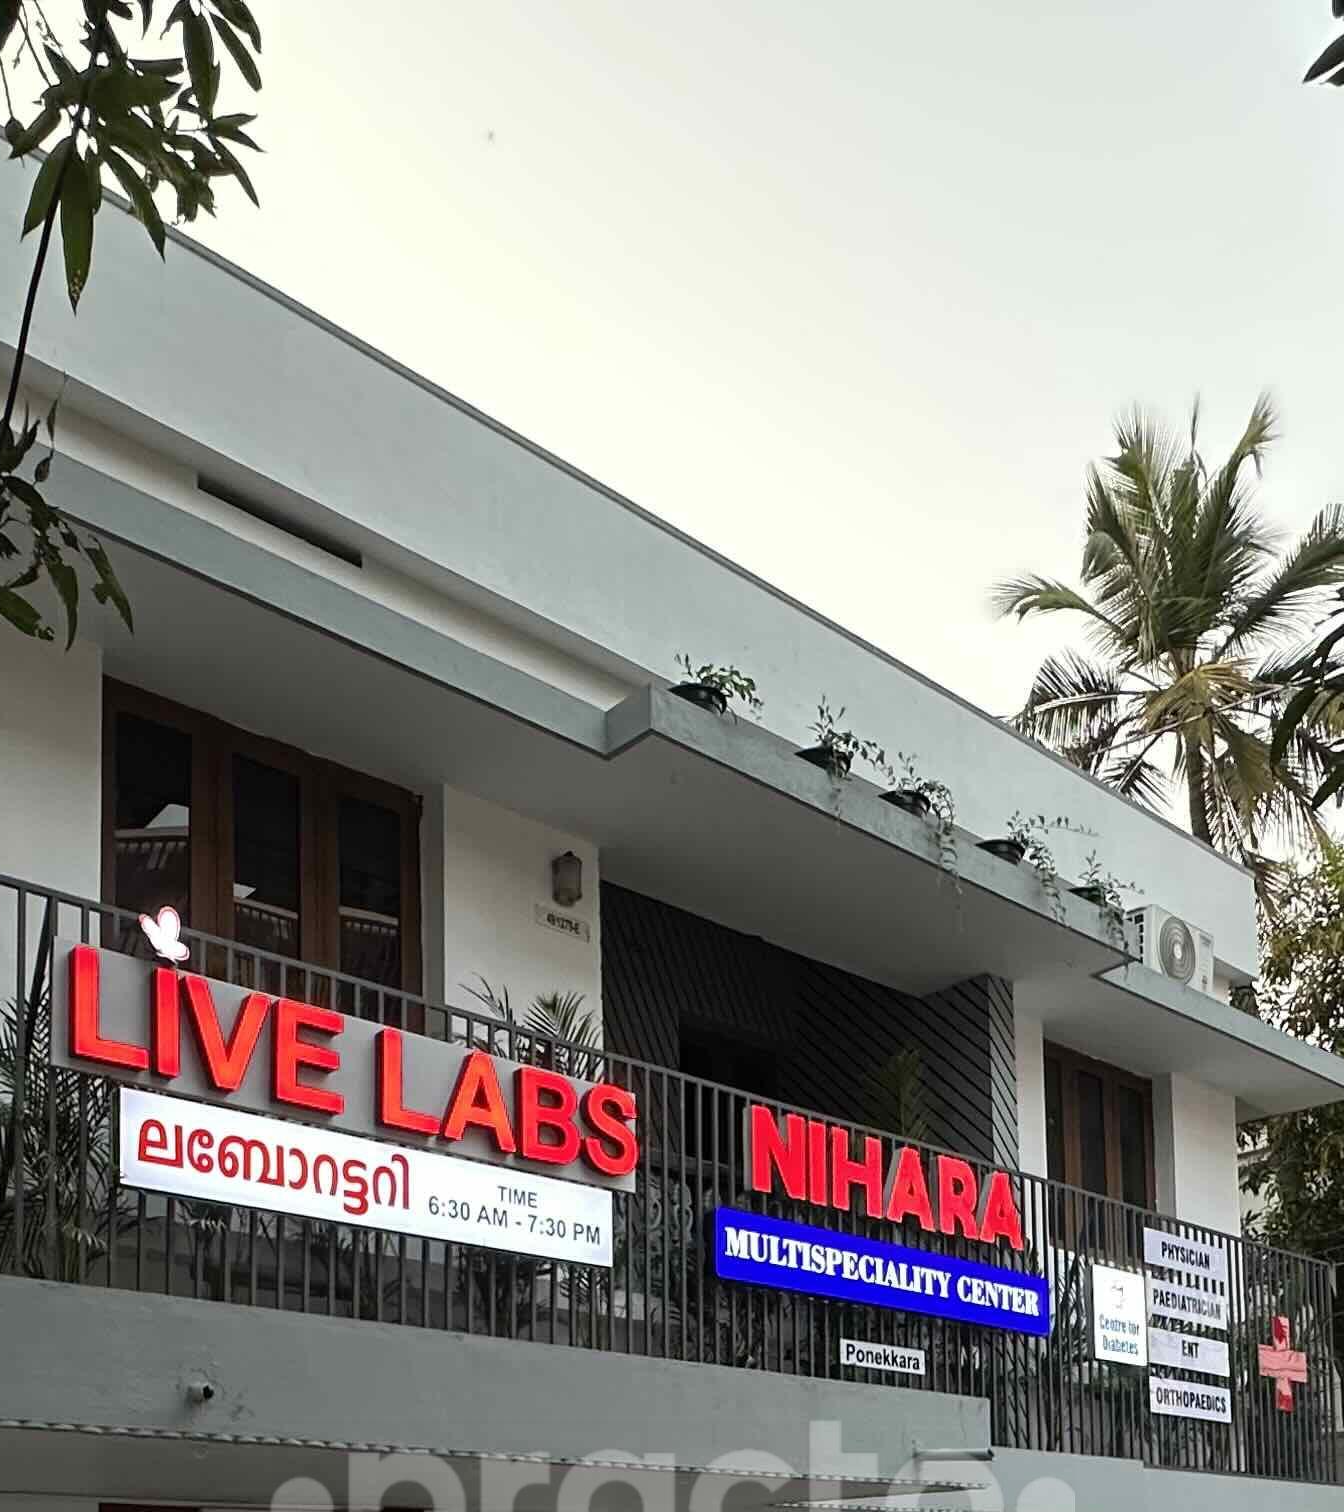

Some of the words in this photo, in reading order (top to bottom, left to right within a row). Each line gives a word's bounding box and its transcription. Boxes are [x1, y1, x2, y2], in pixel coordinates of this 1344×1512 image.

[71, 944, 346, 1115] LIVE
[378, 1027, 638, 1177] LABS
[745, 1103, 1024, 1251] NIHARA
[496, 1184, 539, 1210] TIME
[428, 1195, 473, 1222] 6:30
[477, 1204, 509, 1229] AM
[527, 1212, 568, 1238] 7:30
[573, 1218, 601, 1246] PM
[1161, 1241, 1211, 1270] PHYSICIAN
[724, 1226, 951, 1299] MULTISPECIALITY
[956, 1274, 1039, 1318] CENTER
[1152, 1288, 1222, 1321] PAEDIATRICIAN
[844, 1344, 922, 1371] Ponekkara
[1182, 1339, 1200, 1359] ENT
[1156, 1386, 1227, 1413] ORTHOPAEDICS
